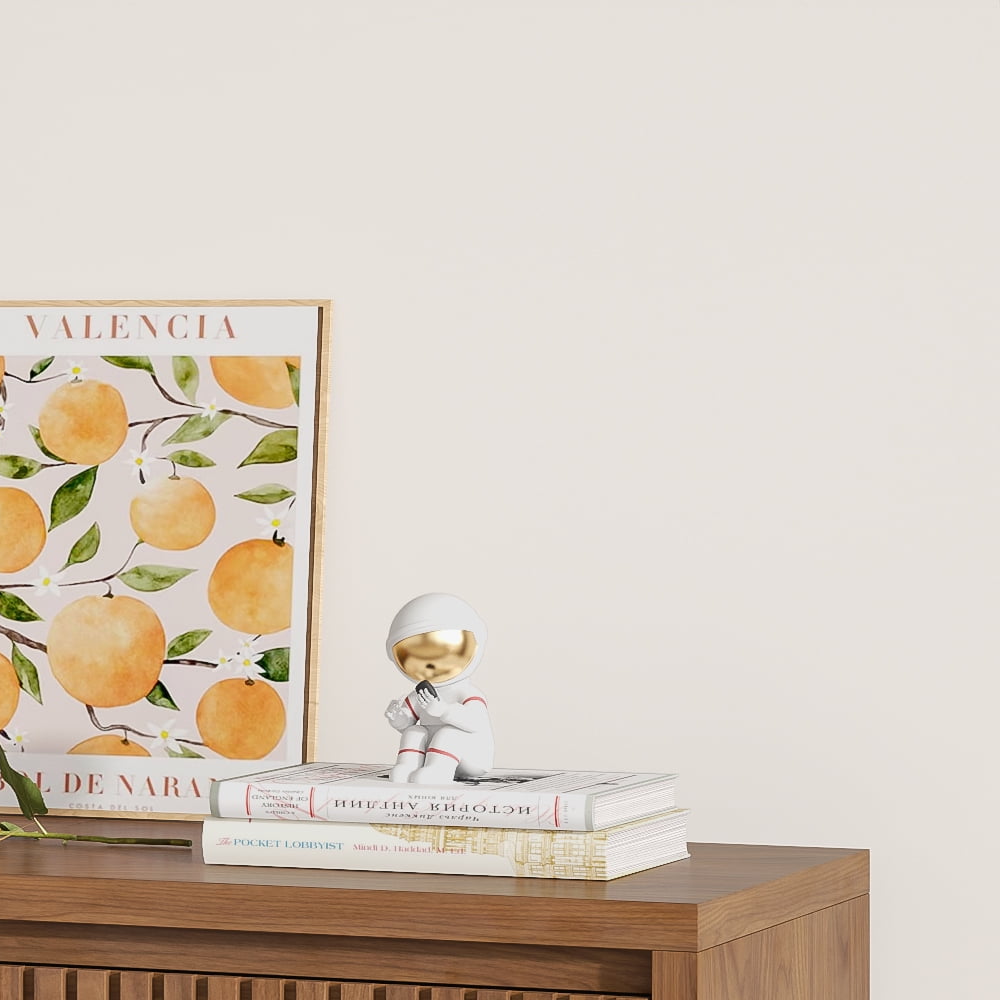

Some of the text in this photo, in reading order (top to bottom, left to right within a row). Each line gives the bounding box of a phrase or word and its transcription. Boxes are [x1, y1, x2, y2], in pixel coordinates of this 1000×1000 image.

[24, 313, 238, 339] VALENCIA
[62, 772, 104, 794] DE
[116, 775, 217, 799] NARA
[68, 802, 103, 810] COSTA
[334, 800, 531, 814] ИСТОРИЯ АНГЛИИ
[216, 837, 234, 846] The
[234, 838, 282, 848] POCKET
[284, 840, 344, 850] LOBBYIST
